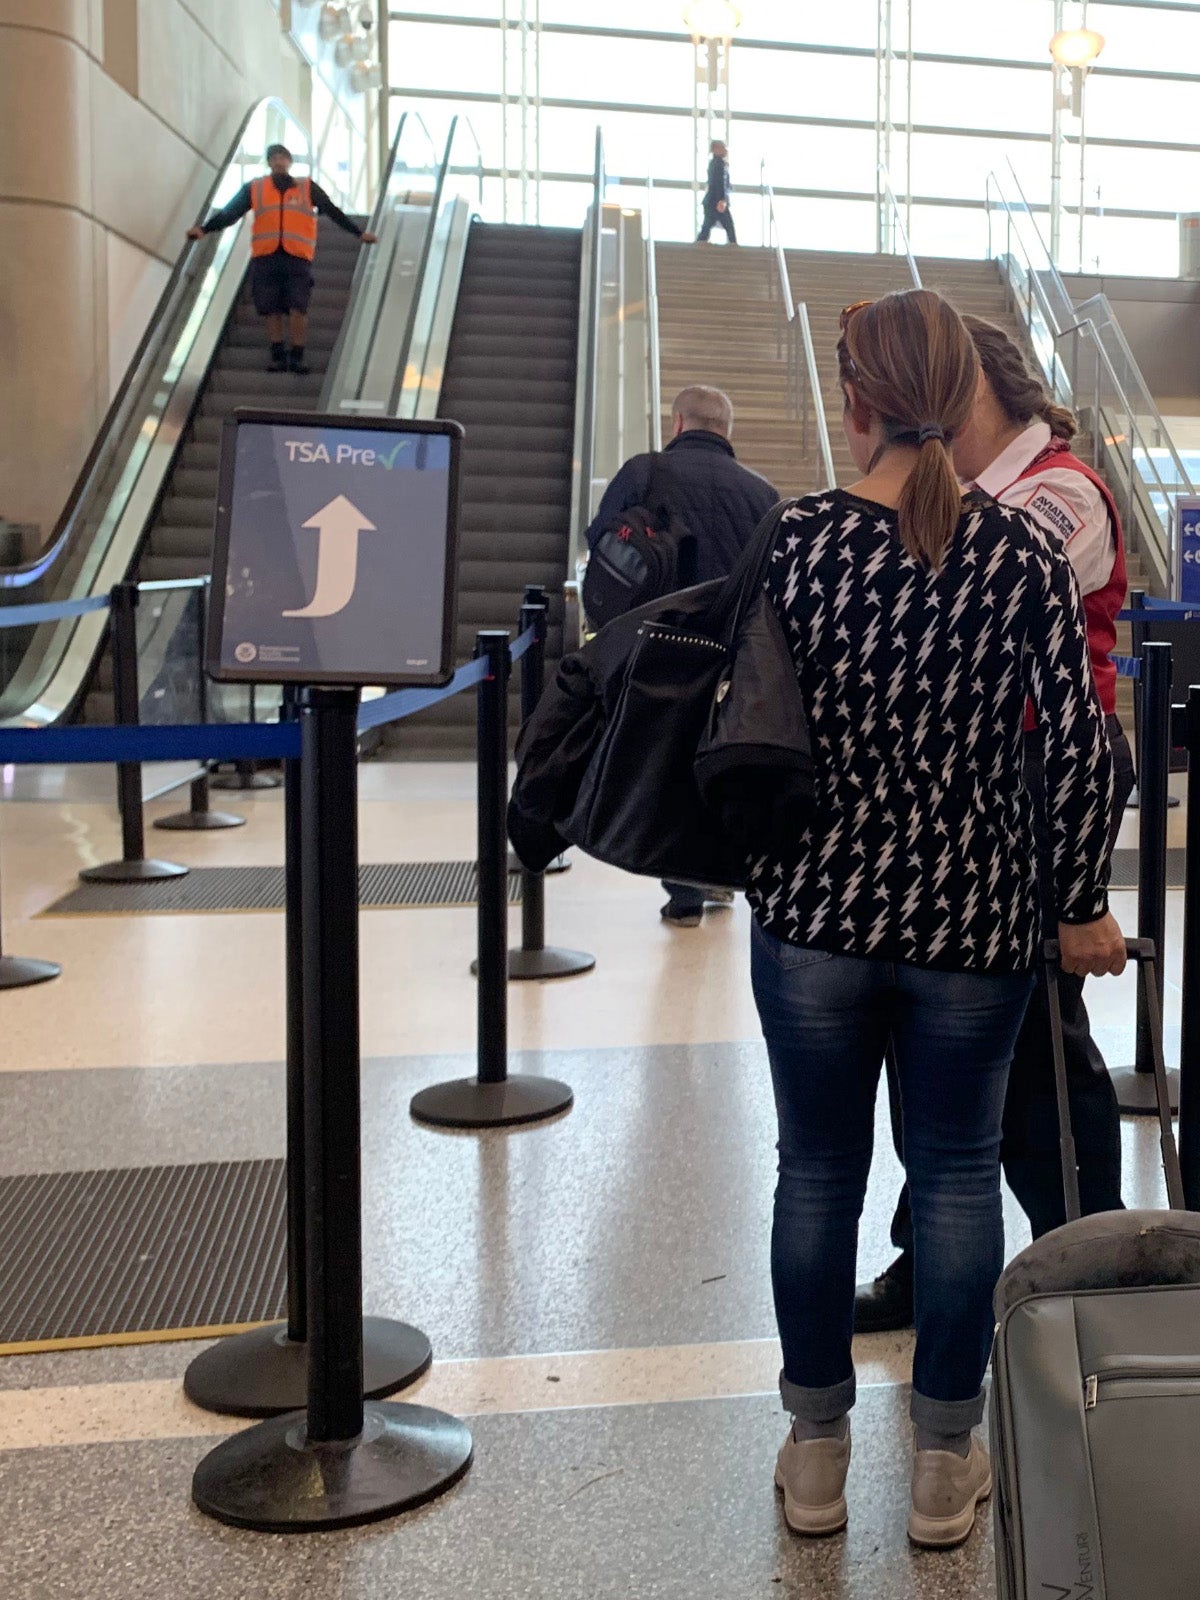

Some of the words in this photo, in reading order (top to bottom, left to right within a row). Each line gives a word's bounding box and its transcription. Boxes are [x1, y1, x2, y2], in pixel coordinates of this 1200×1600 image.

[284, 441, 330, 463] TSA
[336, 444, 376, 467] Pre
[1031, 500, 1070, 539] SAFEGUARDS
[1036, 495, 1076, 534] AVIATION
